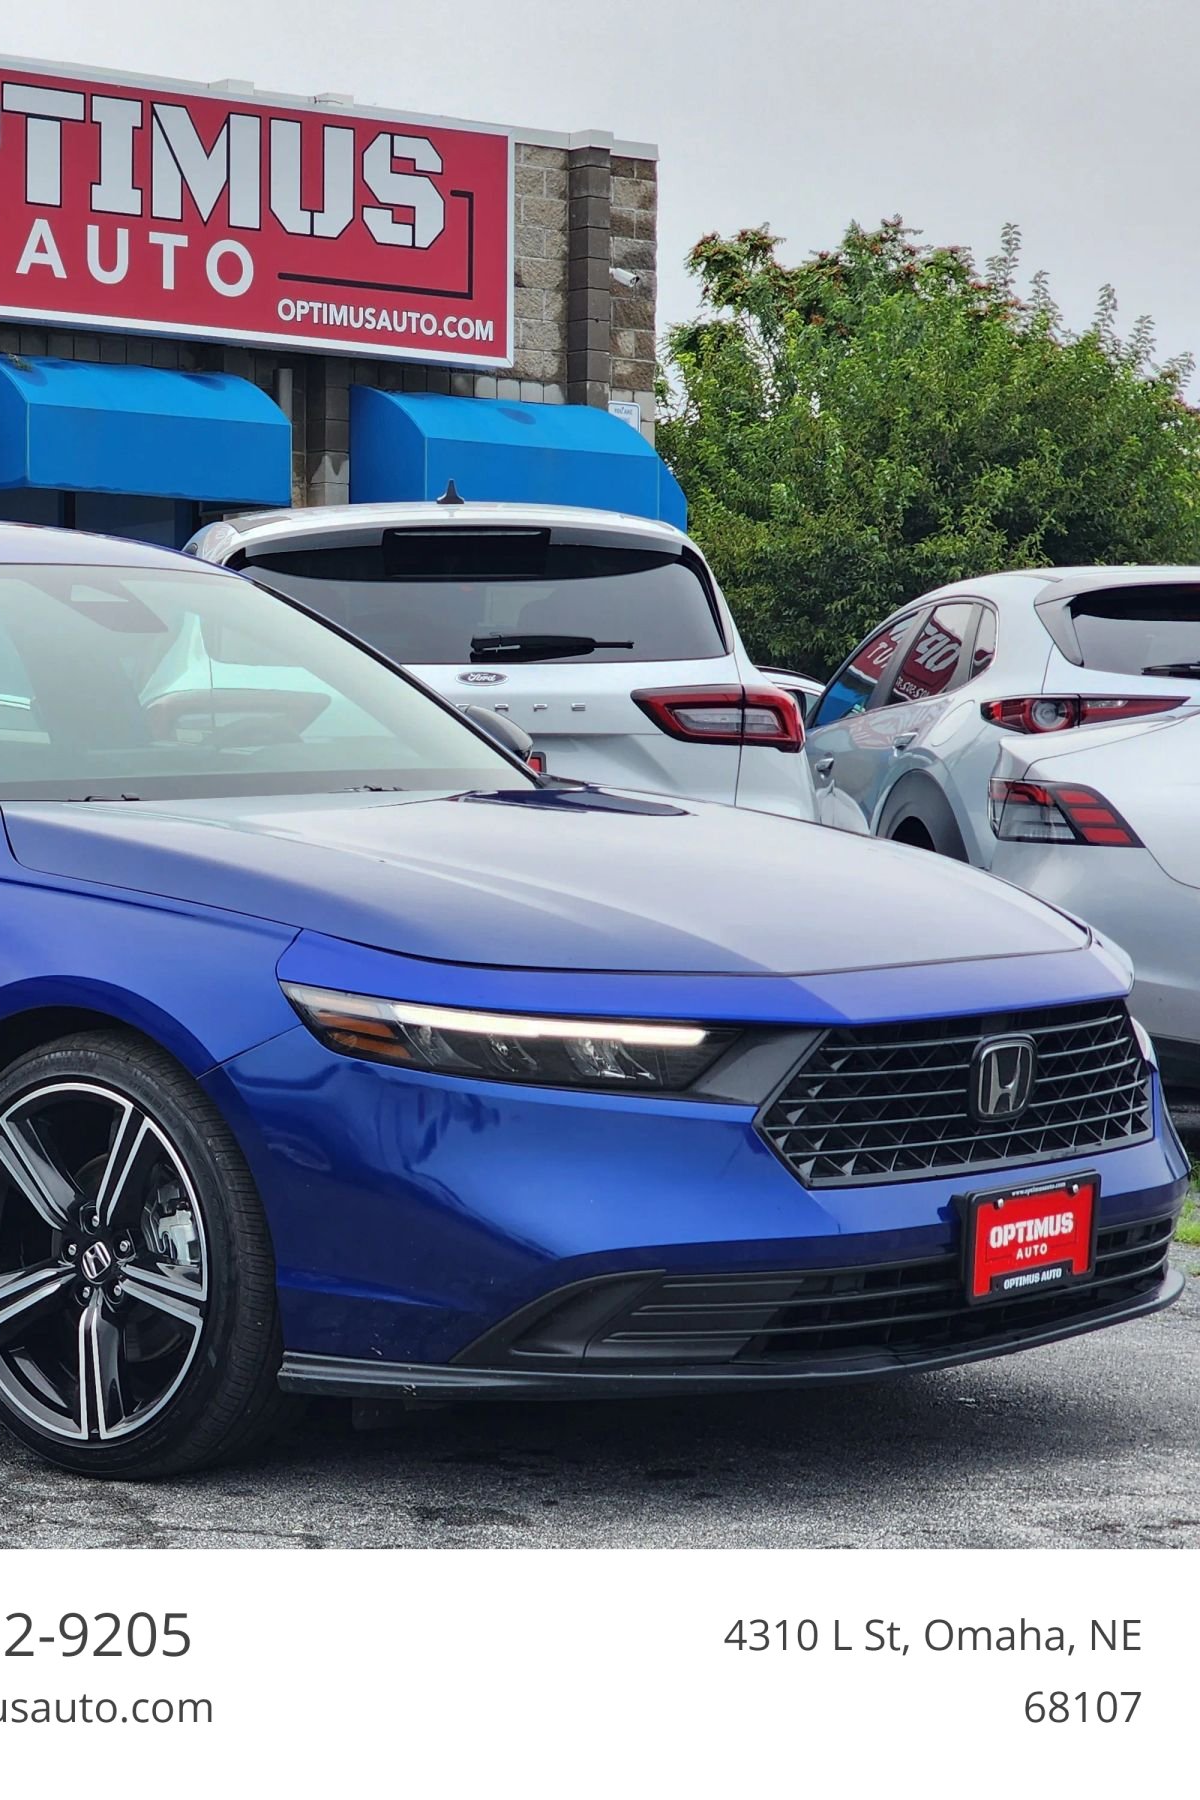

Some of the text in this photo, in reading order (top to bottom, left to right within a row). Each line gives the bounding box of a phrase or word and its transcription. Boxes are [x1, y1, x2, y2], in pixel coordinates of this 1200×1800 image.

[15, 218, 254, 297] AUTO
[277, 298, 494, 342] OPTIMUSAUTO.COM
[989, 1212, 1074, 1249] OPTIMUS
[1016, 1243, 1048, 1260] AUTO
[1003, 1267, 1062, 1290] OPTIMUS AUTO
